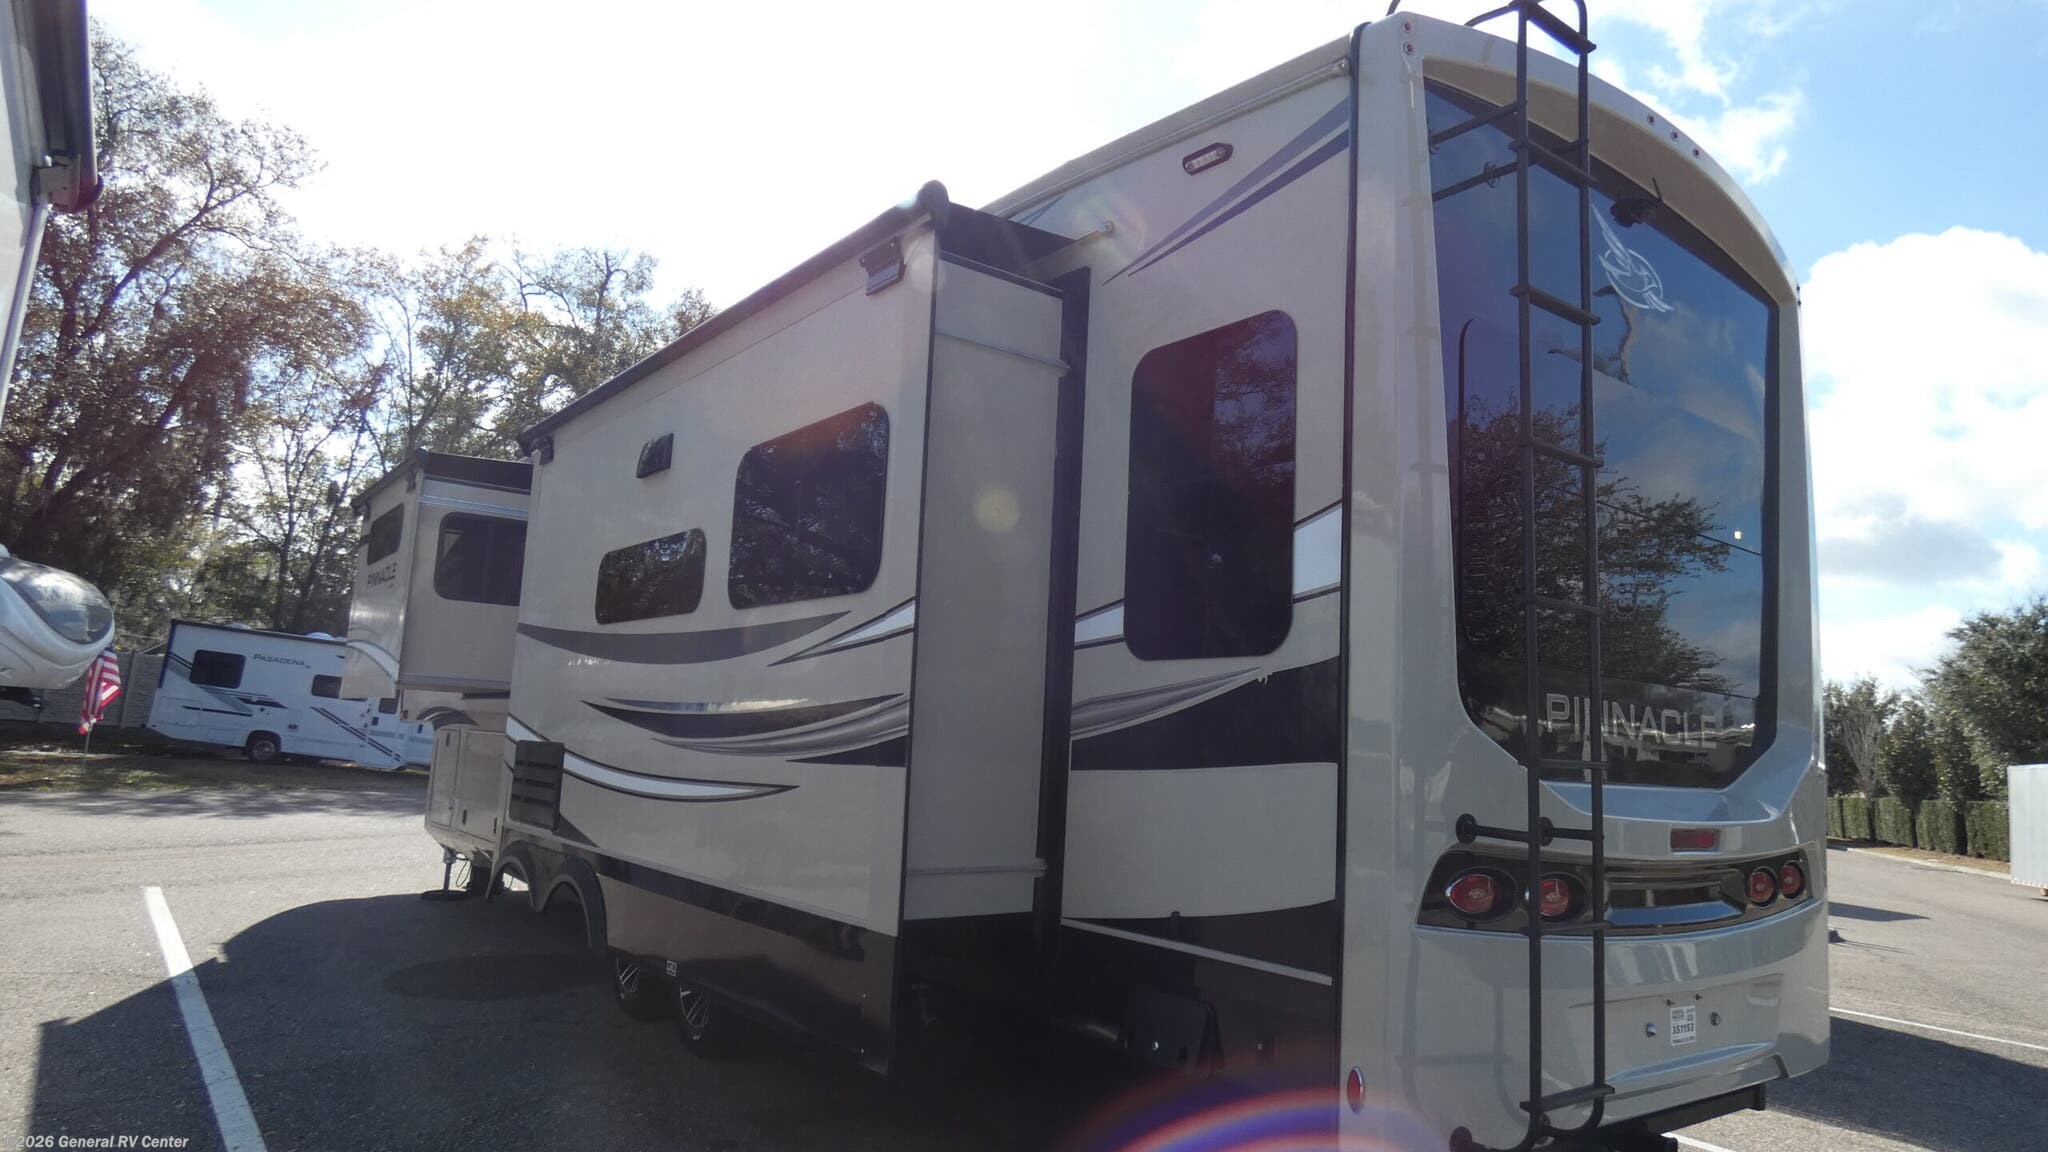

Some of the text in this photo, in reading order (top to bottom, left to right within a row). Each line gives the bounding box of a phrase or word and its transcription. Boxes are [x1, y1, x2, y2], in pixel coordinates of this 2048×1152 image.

[367, 562, 397, 585] PINNACLE
[1546, 692, 1717, 750] PINNACLE
[1672, 1022, 1694, 1035] 351153
